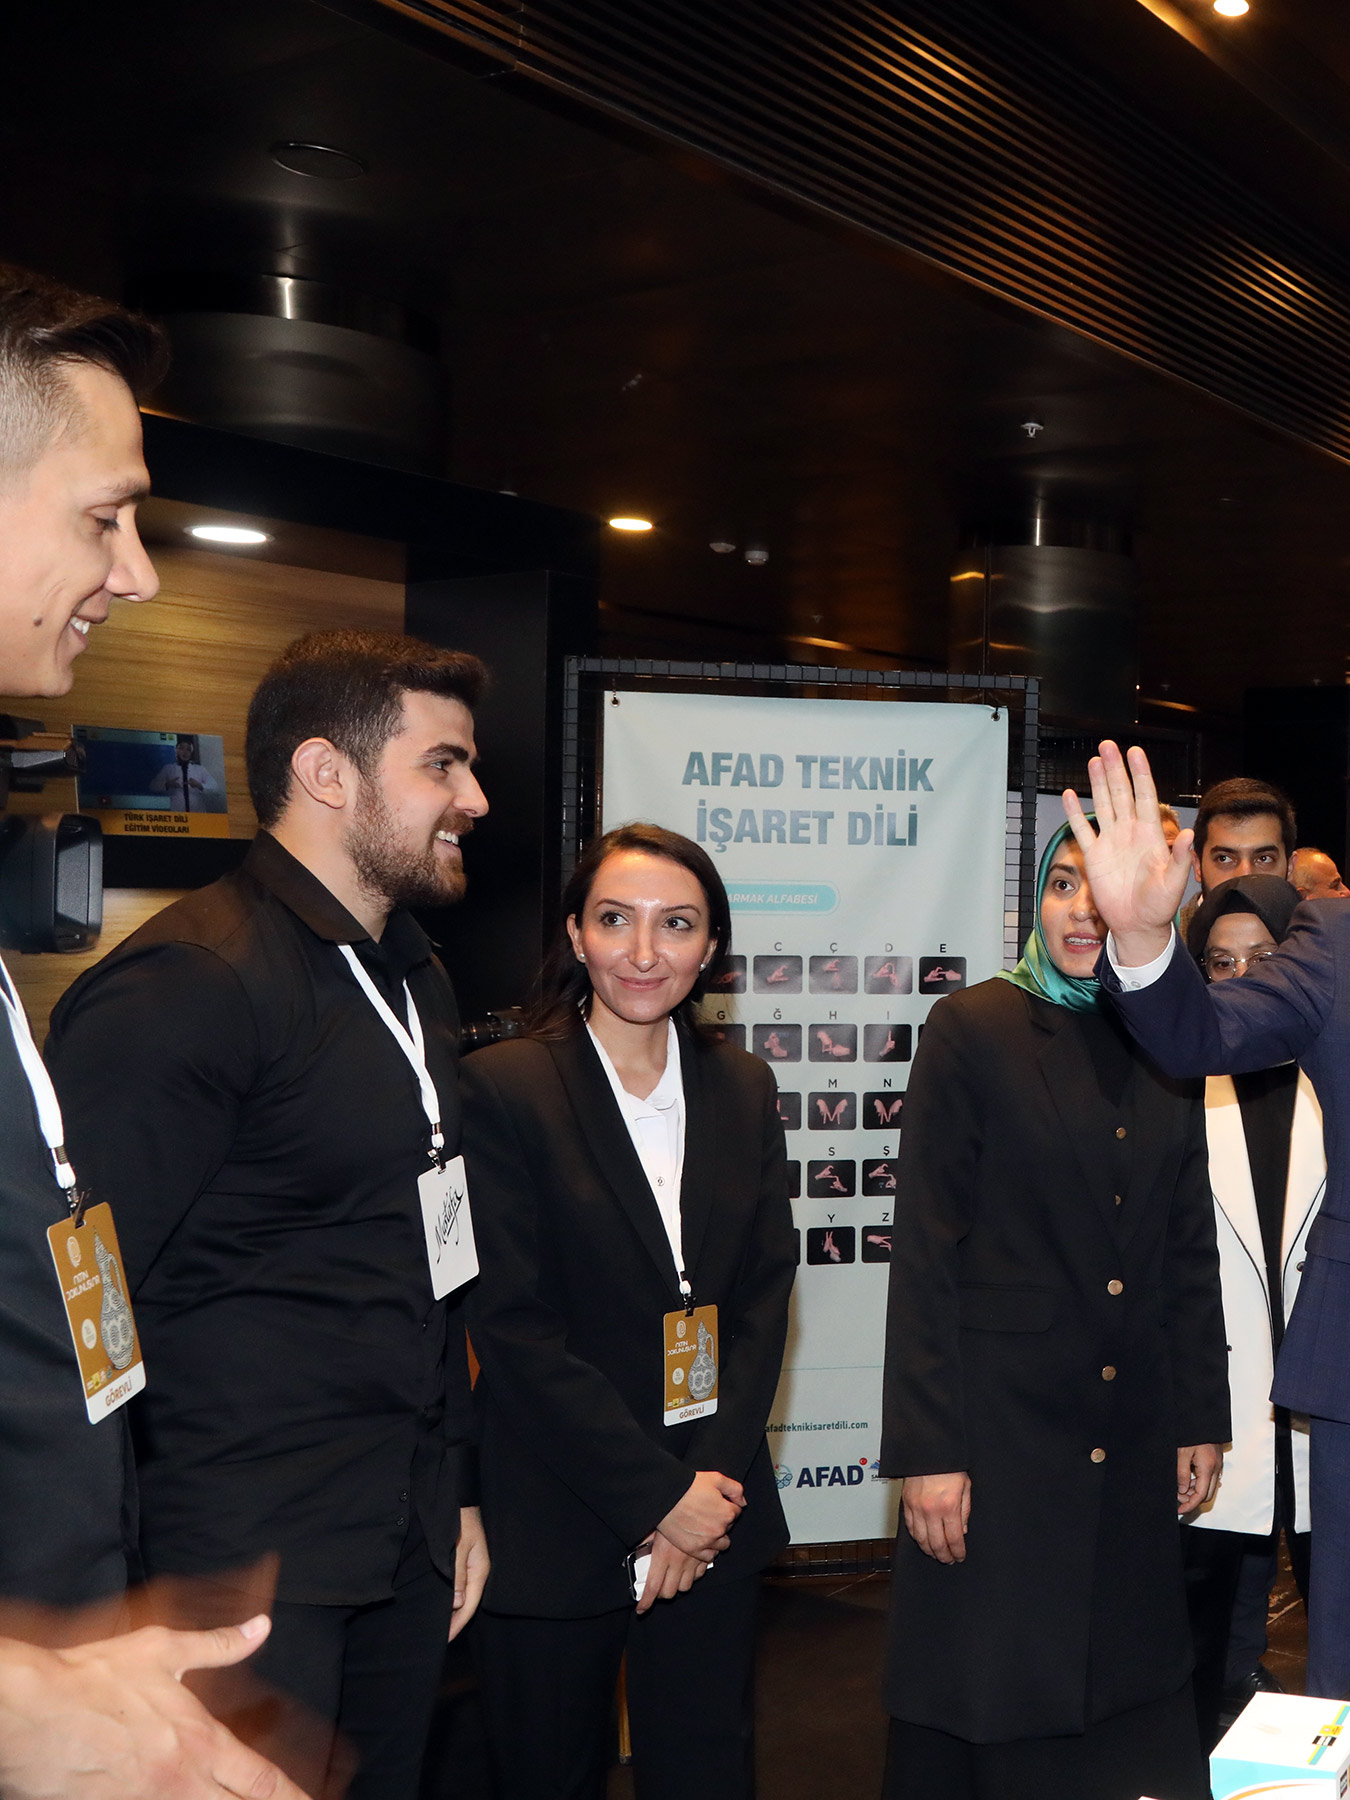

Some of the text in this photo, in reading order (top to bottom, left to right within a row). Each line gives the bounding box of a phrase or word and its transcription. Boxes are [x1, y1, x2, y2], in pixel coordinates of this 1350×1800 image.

[682, 749, 935, 792] AFAD TEKNİK
[124, 811, 145, 821] TÜRK
[146, 812, 172, 823] İŞARET
[124, 822, 190, 833] EĞİTİM VİDEOLARI
[696, 800, 919, 853] İŞARET DİLİ
[727, 893, 819, 904] ARMAK ALFABESİ
[774, 942, 947, 954] C Ç D E
[716, 1010, 726, 1021] G
[773, 1008, 782, 1021] Ğ
[829, 1011, 838, 1021] H
[828, 1078, 892, 1089] M N
[828, 1145, 890, 1157] S Ş
[827, 1213, 890, 1224] Y Z
[105, 1376, 132, 1406] GÖREVLİ
[679, 1405, 705, 1419] GÖREVLİ
[796, 1465, 865, 1488] AFAD
